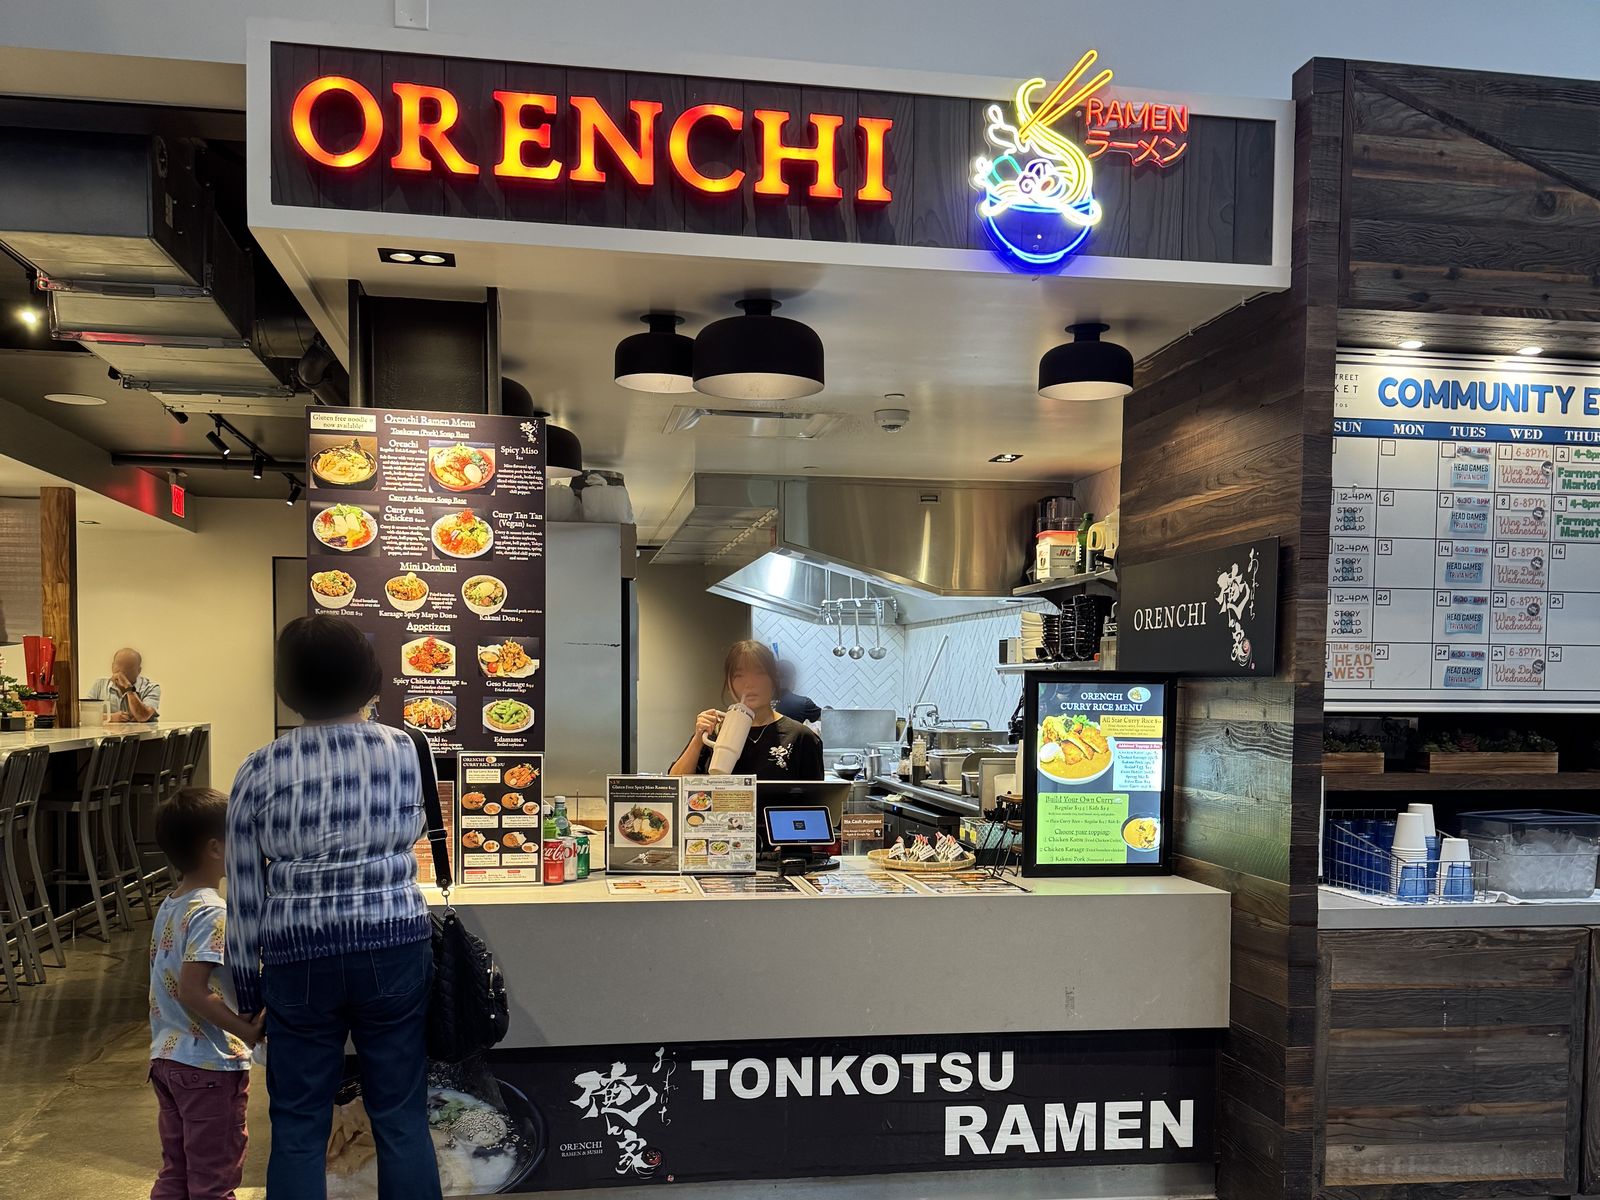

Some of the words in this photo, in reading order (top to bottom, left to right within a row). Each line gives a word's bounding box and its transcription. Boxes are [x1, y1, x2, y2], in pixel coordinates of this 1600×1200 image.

[1086, 97, 1189, 133] RAMEN
[290, 74, 894, 202] ORENCHI
[1086, 130, 1187, 165] ラーメン
[1378, 377, 1575, 415] COMMUNITY
[384, 414, 418, 423] Orenchi
[420, 416, 449, 425] Ramen
[451, 418, 475, 427] Menu
[1334, 421, 1362, 432] SUN
[1394, 424, 1424, 435] MON
[1451, 426, 1486, 438] TUES
[1510, 428, 1543, 440] WED
[389, 440, 418, 448] Orenchi
[501, 446, 519, 456] Spicy
[1516, 448, 1549, 459] 6-8PM
[1560, 450, 1565, 459] 2
[1502, 474, 1550, 487] Wednesday
[1443, 497, 1449, 505] 7
[1513, 498, 1546, 508] 6-8PM
[385, 506, 407, 514] Curry
[408, 506, 424, 514] with
[493, 511, 513, 520] Curry
[1466, 512, 1485, 521] GAMES
[498, 520, 525, 528] (Vegan)
[1500, 525, 1547, 537] Wednesday
[1380, 543, 1390, 553] 13
[1512, 548, 1544, 556] 6-8PM
[400, 562, 420, 570] Mini
[422, 563, 457, 572] Donburi
[1462, 562, 1482, 570] GAMES
[1498, 574, 1545, 586] Wednesday
[1377, 593, 1388, 602] 20
[1510, 596, 1543, 606] 6-8PM
[379, 610, 403, 619] Karaage
[404, 611, 420, 619] Spicy
[1134, 602, 1207, 631] ORENCHI
[1462, 614, 1482, 622] GAMES
[406, 622, 451, 633] Appetizers
[1496, 621, 1543, 632] Wednesday
[1509, 648, 1542, 657] 6-8PM
[1335, 654, 1372, 666] HEAD
[1334, 667, 1375, 679] WEST
[1462, 666, 1481, 675] GAMES
[1496, 672, 1543, 685] Wednesday
[503, 681, 526, 689] Karaage
[1081, 692, 1123, 701] ORENCHI
[1060, 702, 1091, 710] CURRY
[1093, 703, 1114, 711] RICE
[1115, 703, 1143, 712] MENU
[691, 1051, 1015, 1101] TONKOTSU
[944, 1099, 1195, 1156] RAMEN
[559, 1141, 602, 1152] ORENCHI
